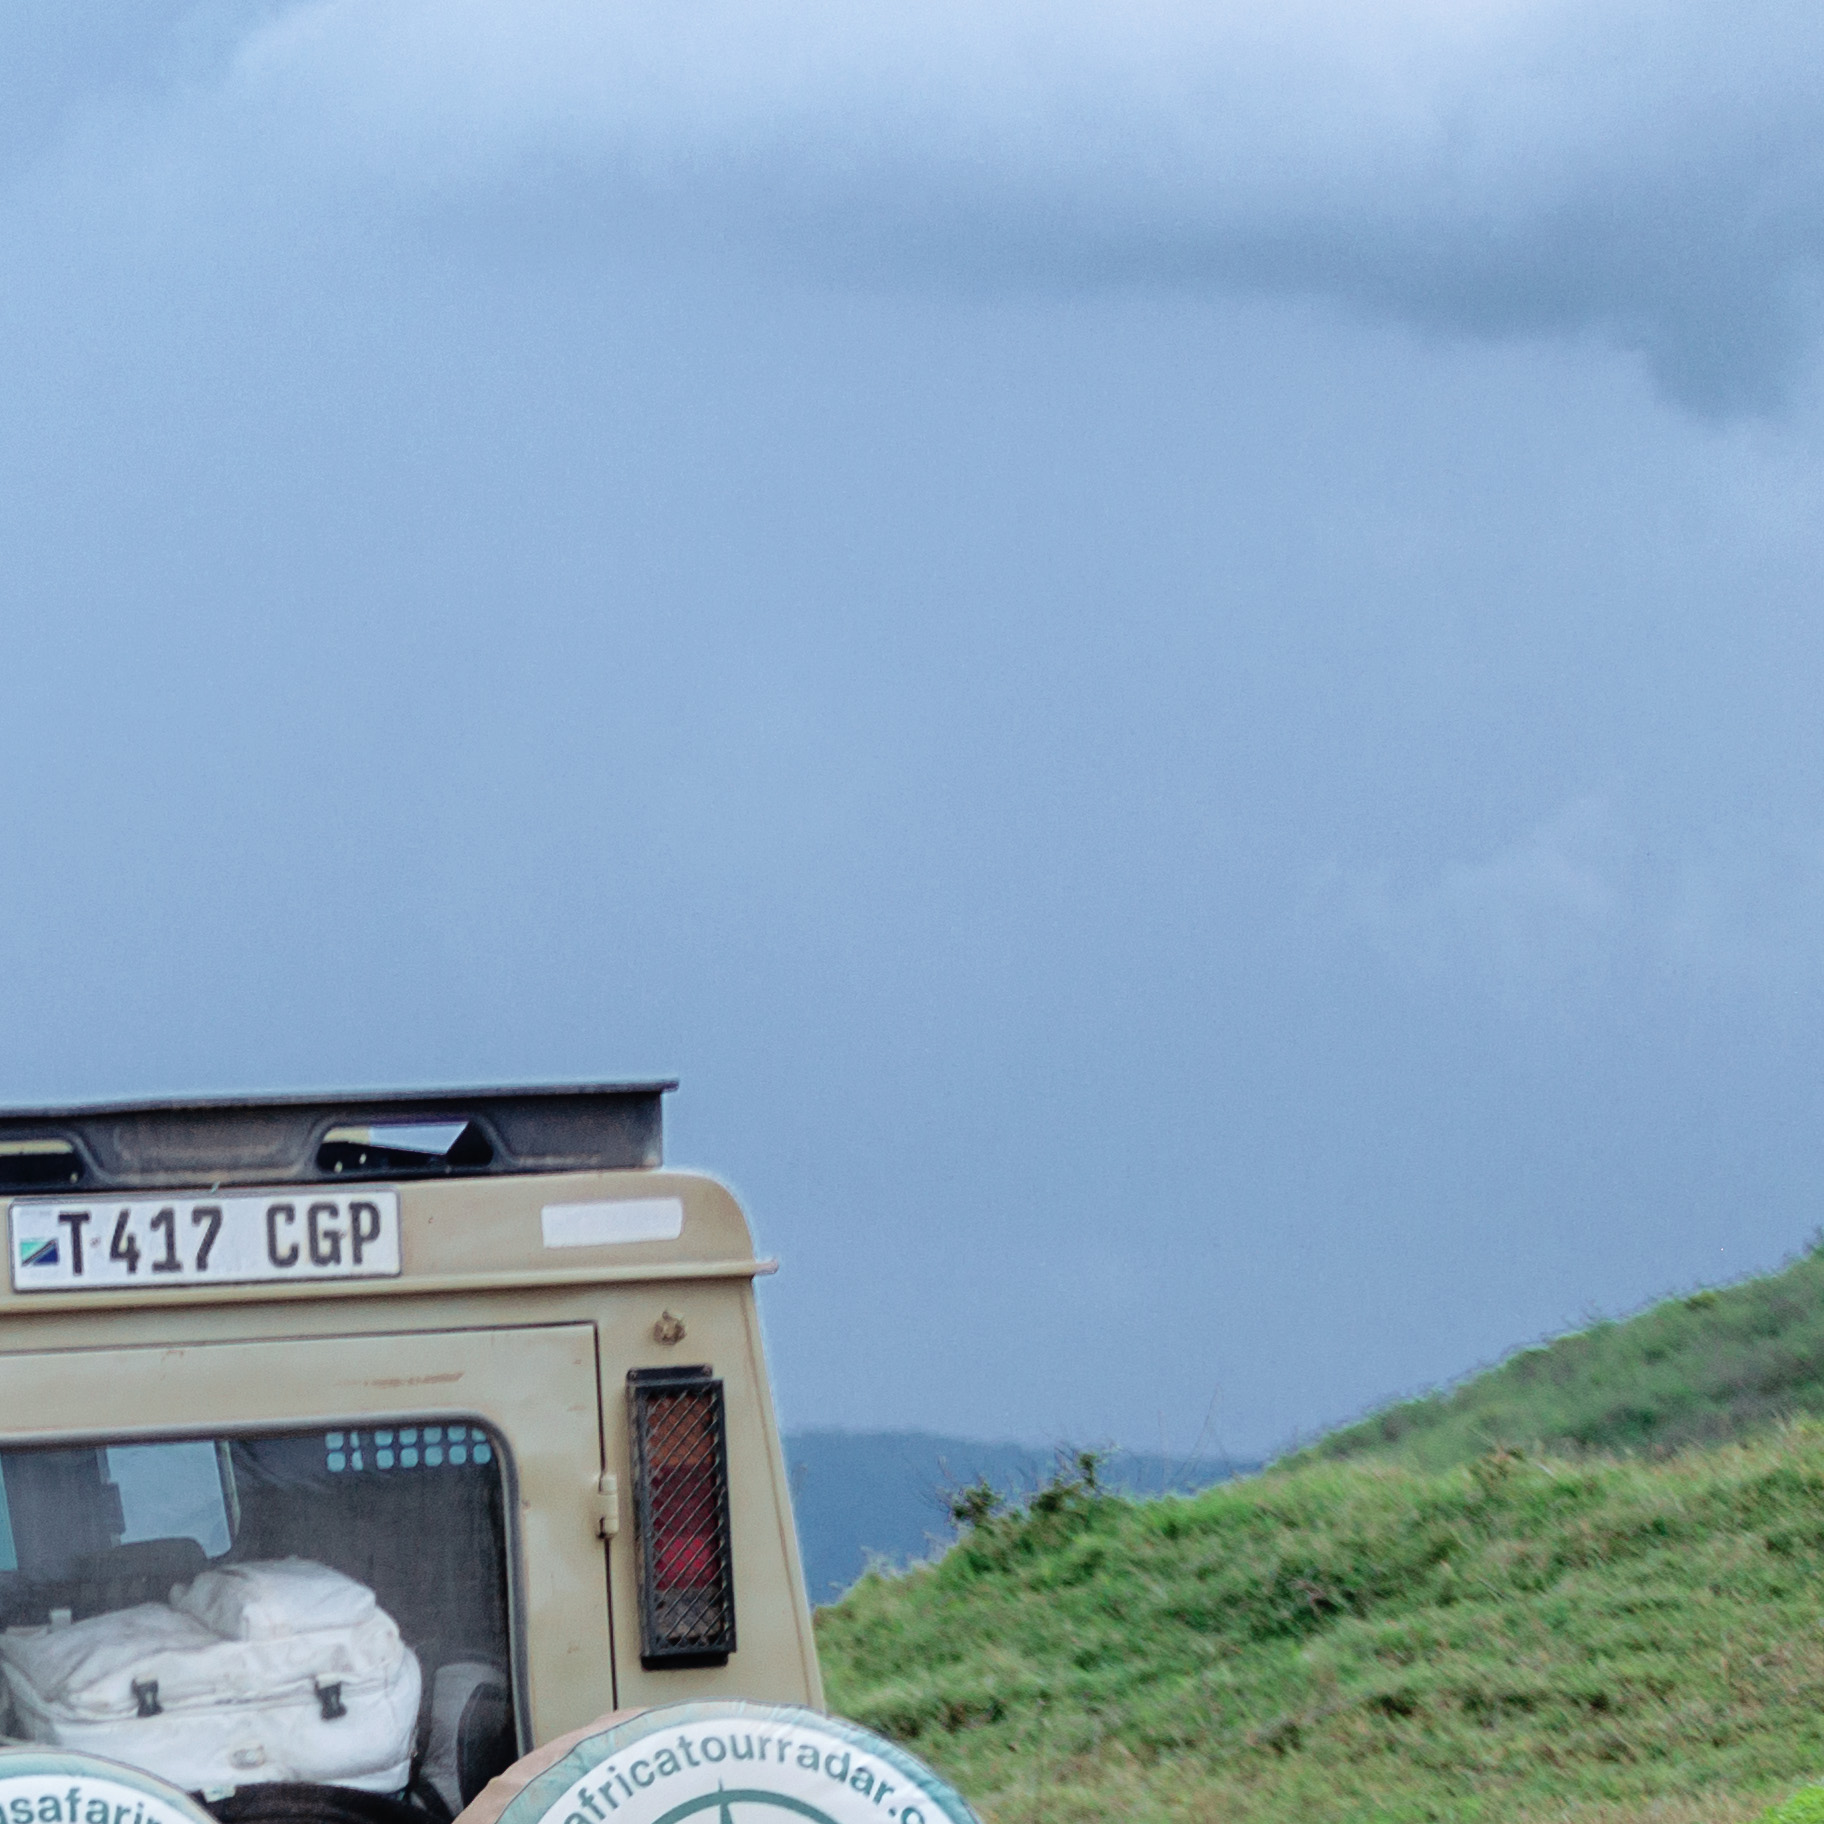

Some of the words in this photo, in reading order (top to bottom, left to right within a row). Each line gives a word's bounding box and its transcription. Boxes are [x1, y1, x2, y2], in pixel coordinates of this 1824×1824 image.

[57, 1210, 92, 1276] T
[109, 1206, 223, 1275] 417
[266, 1200, 382, 1268] CGP
